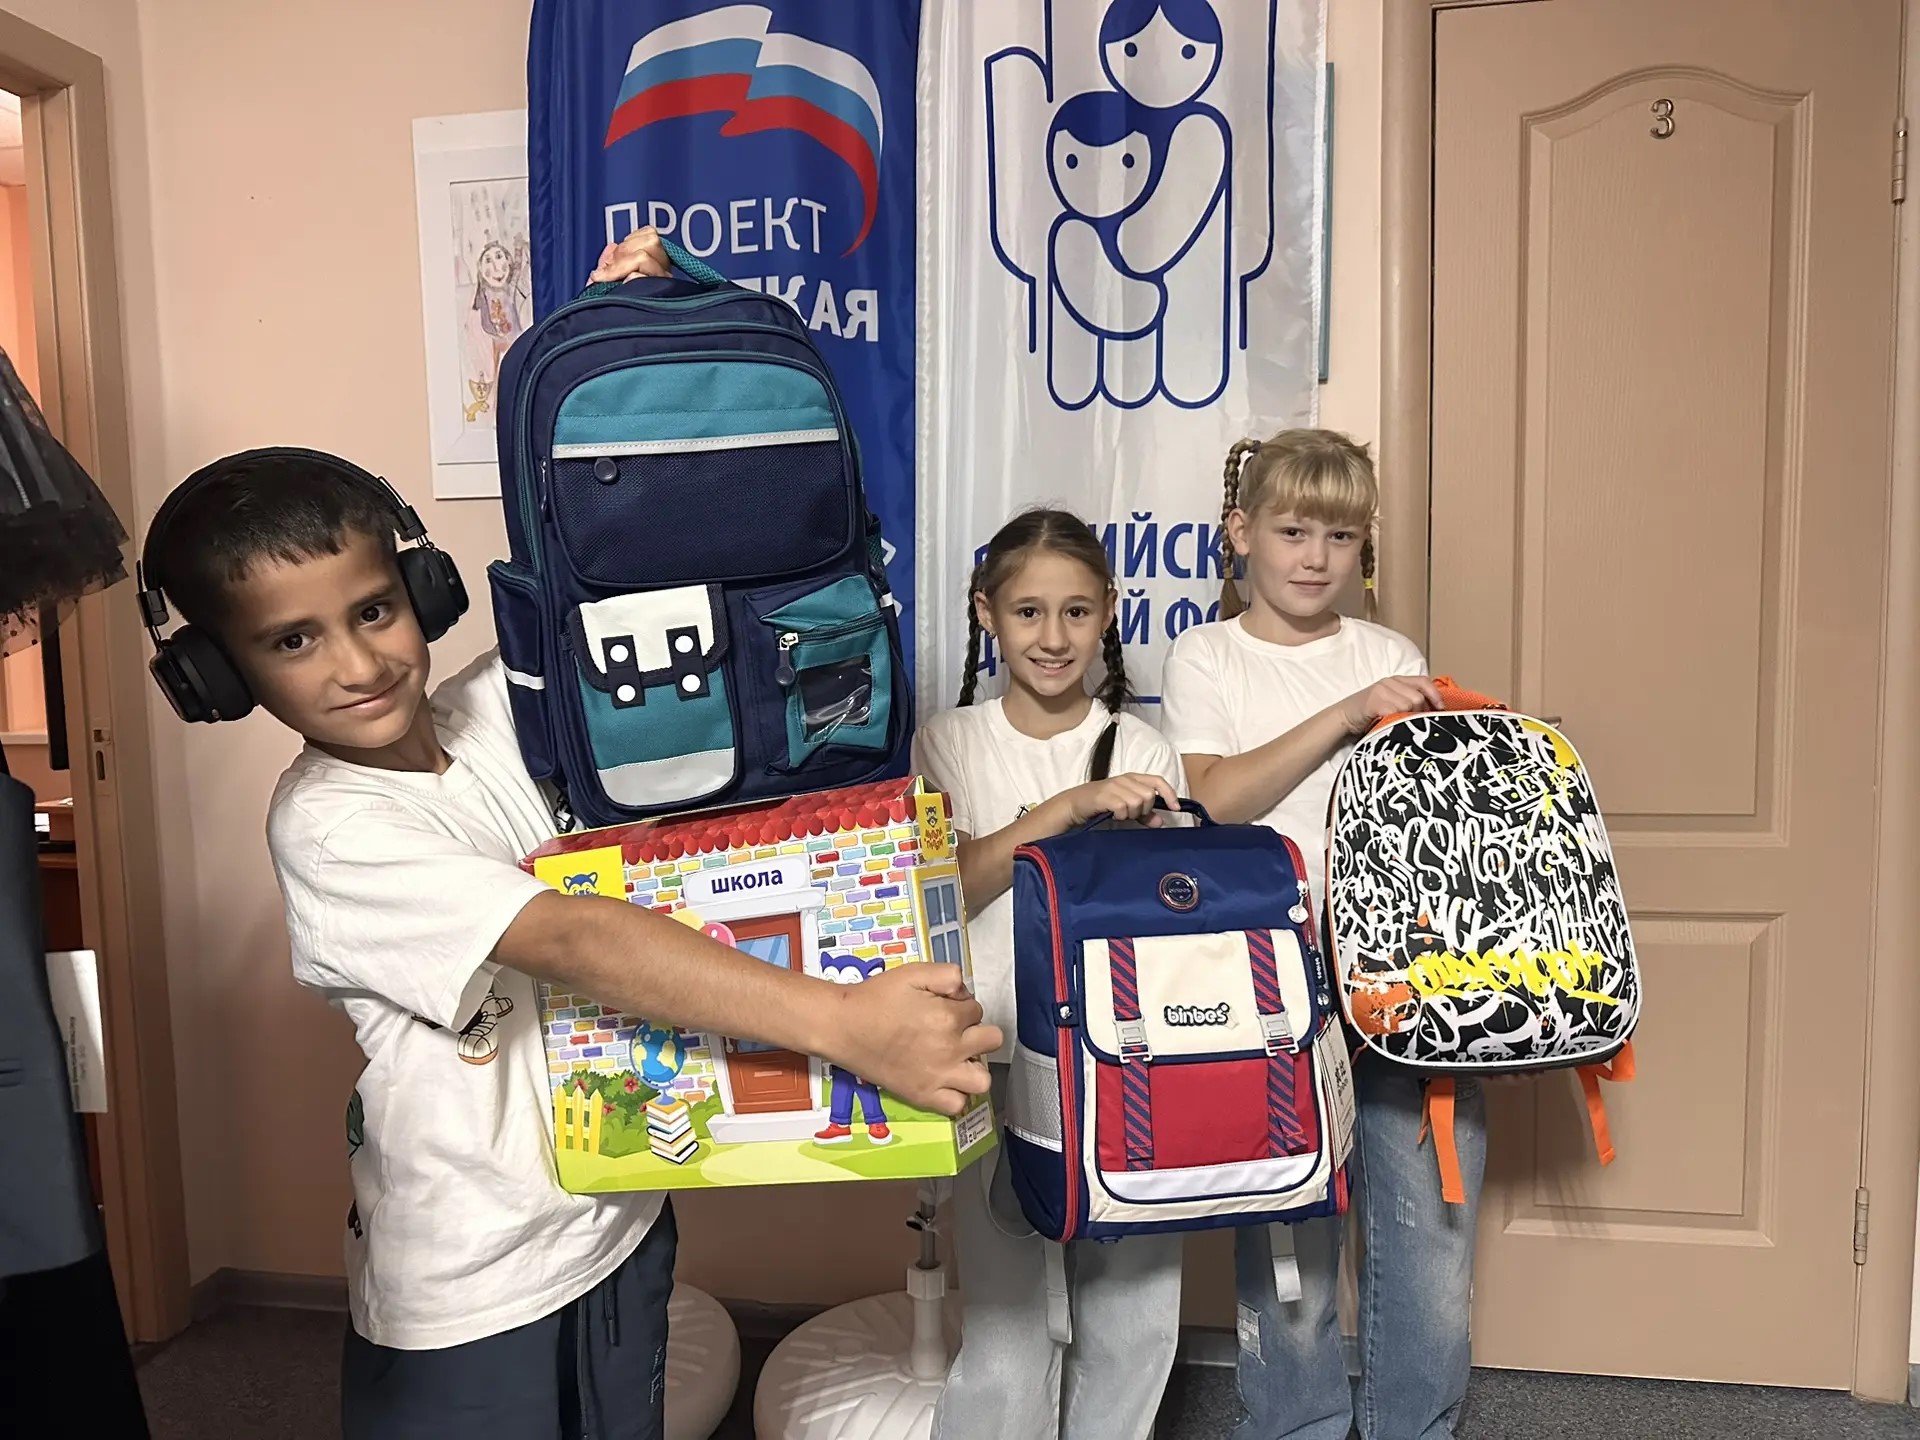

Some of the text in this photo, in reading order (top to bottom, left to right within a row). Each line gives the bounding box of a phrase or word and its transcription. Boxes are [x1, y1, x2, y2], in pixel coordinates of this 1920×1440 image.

[1649, 98, 1675, 139] 3
[605, 198, 827, 257] ПРОЕКТ
[711, 869, 783, 894] школа
[1164, 1002, 1230, 1027] binbes
